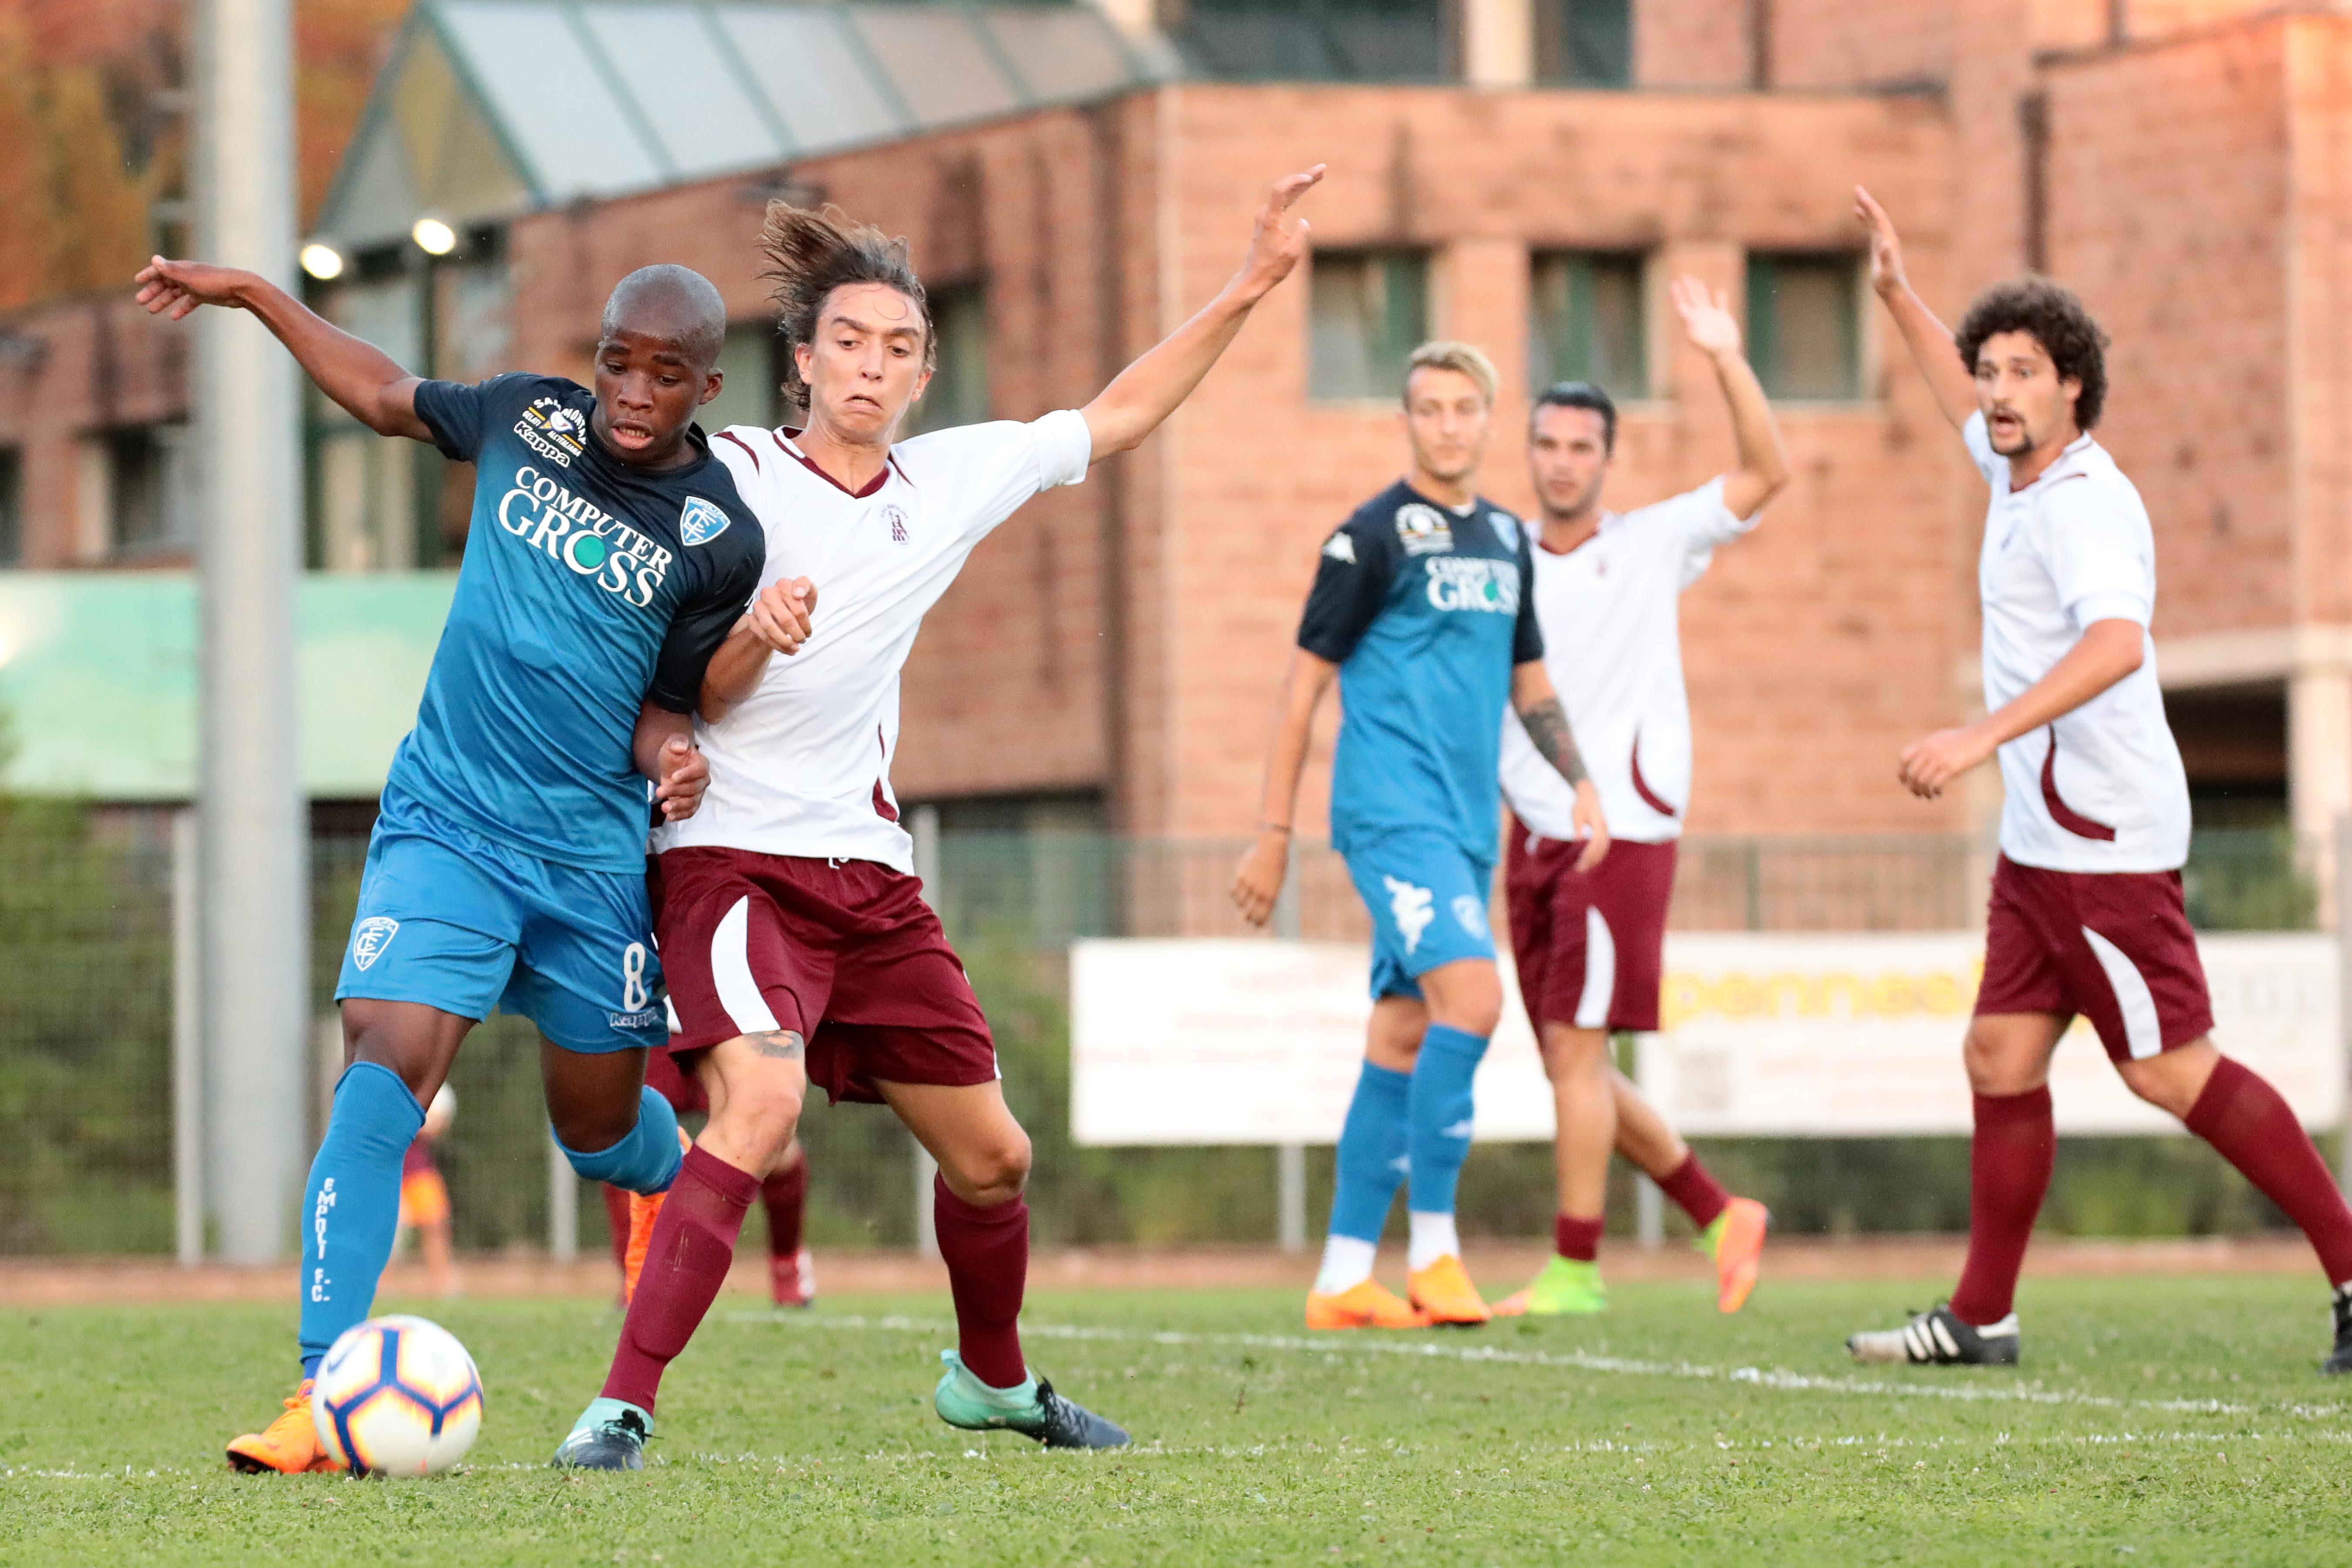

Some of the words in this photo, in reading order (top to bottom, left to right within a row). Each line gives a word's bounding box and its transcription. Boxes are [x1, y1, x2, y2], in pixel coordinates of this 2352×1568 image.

[514, 420, 571, 468] Kappa
[522, 410, 542, 426] GELATI
[498, 489, 664, 608] GROSS
[516, 466, 672, 575] COMPUTER
[624, 942, 647, 1012] 8
[315, 1177, 337, 1260] EMPOLI
